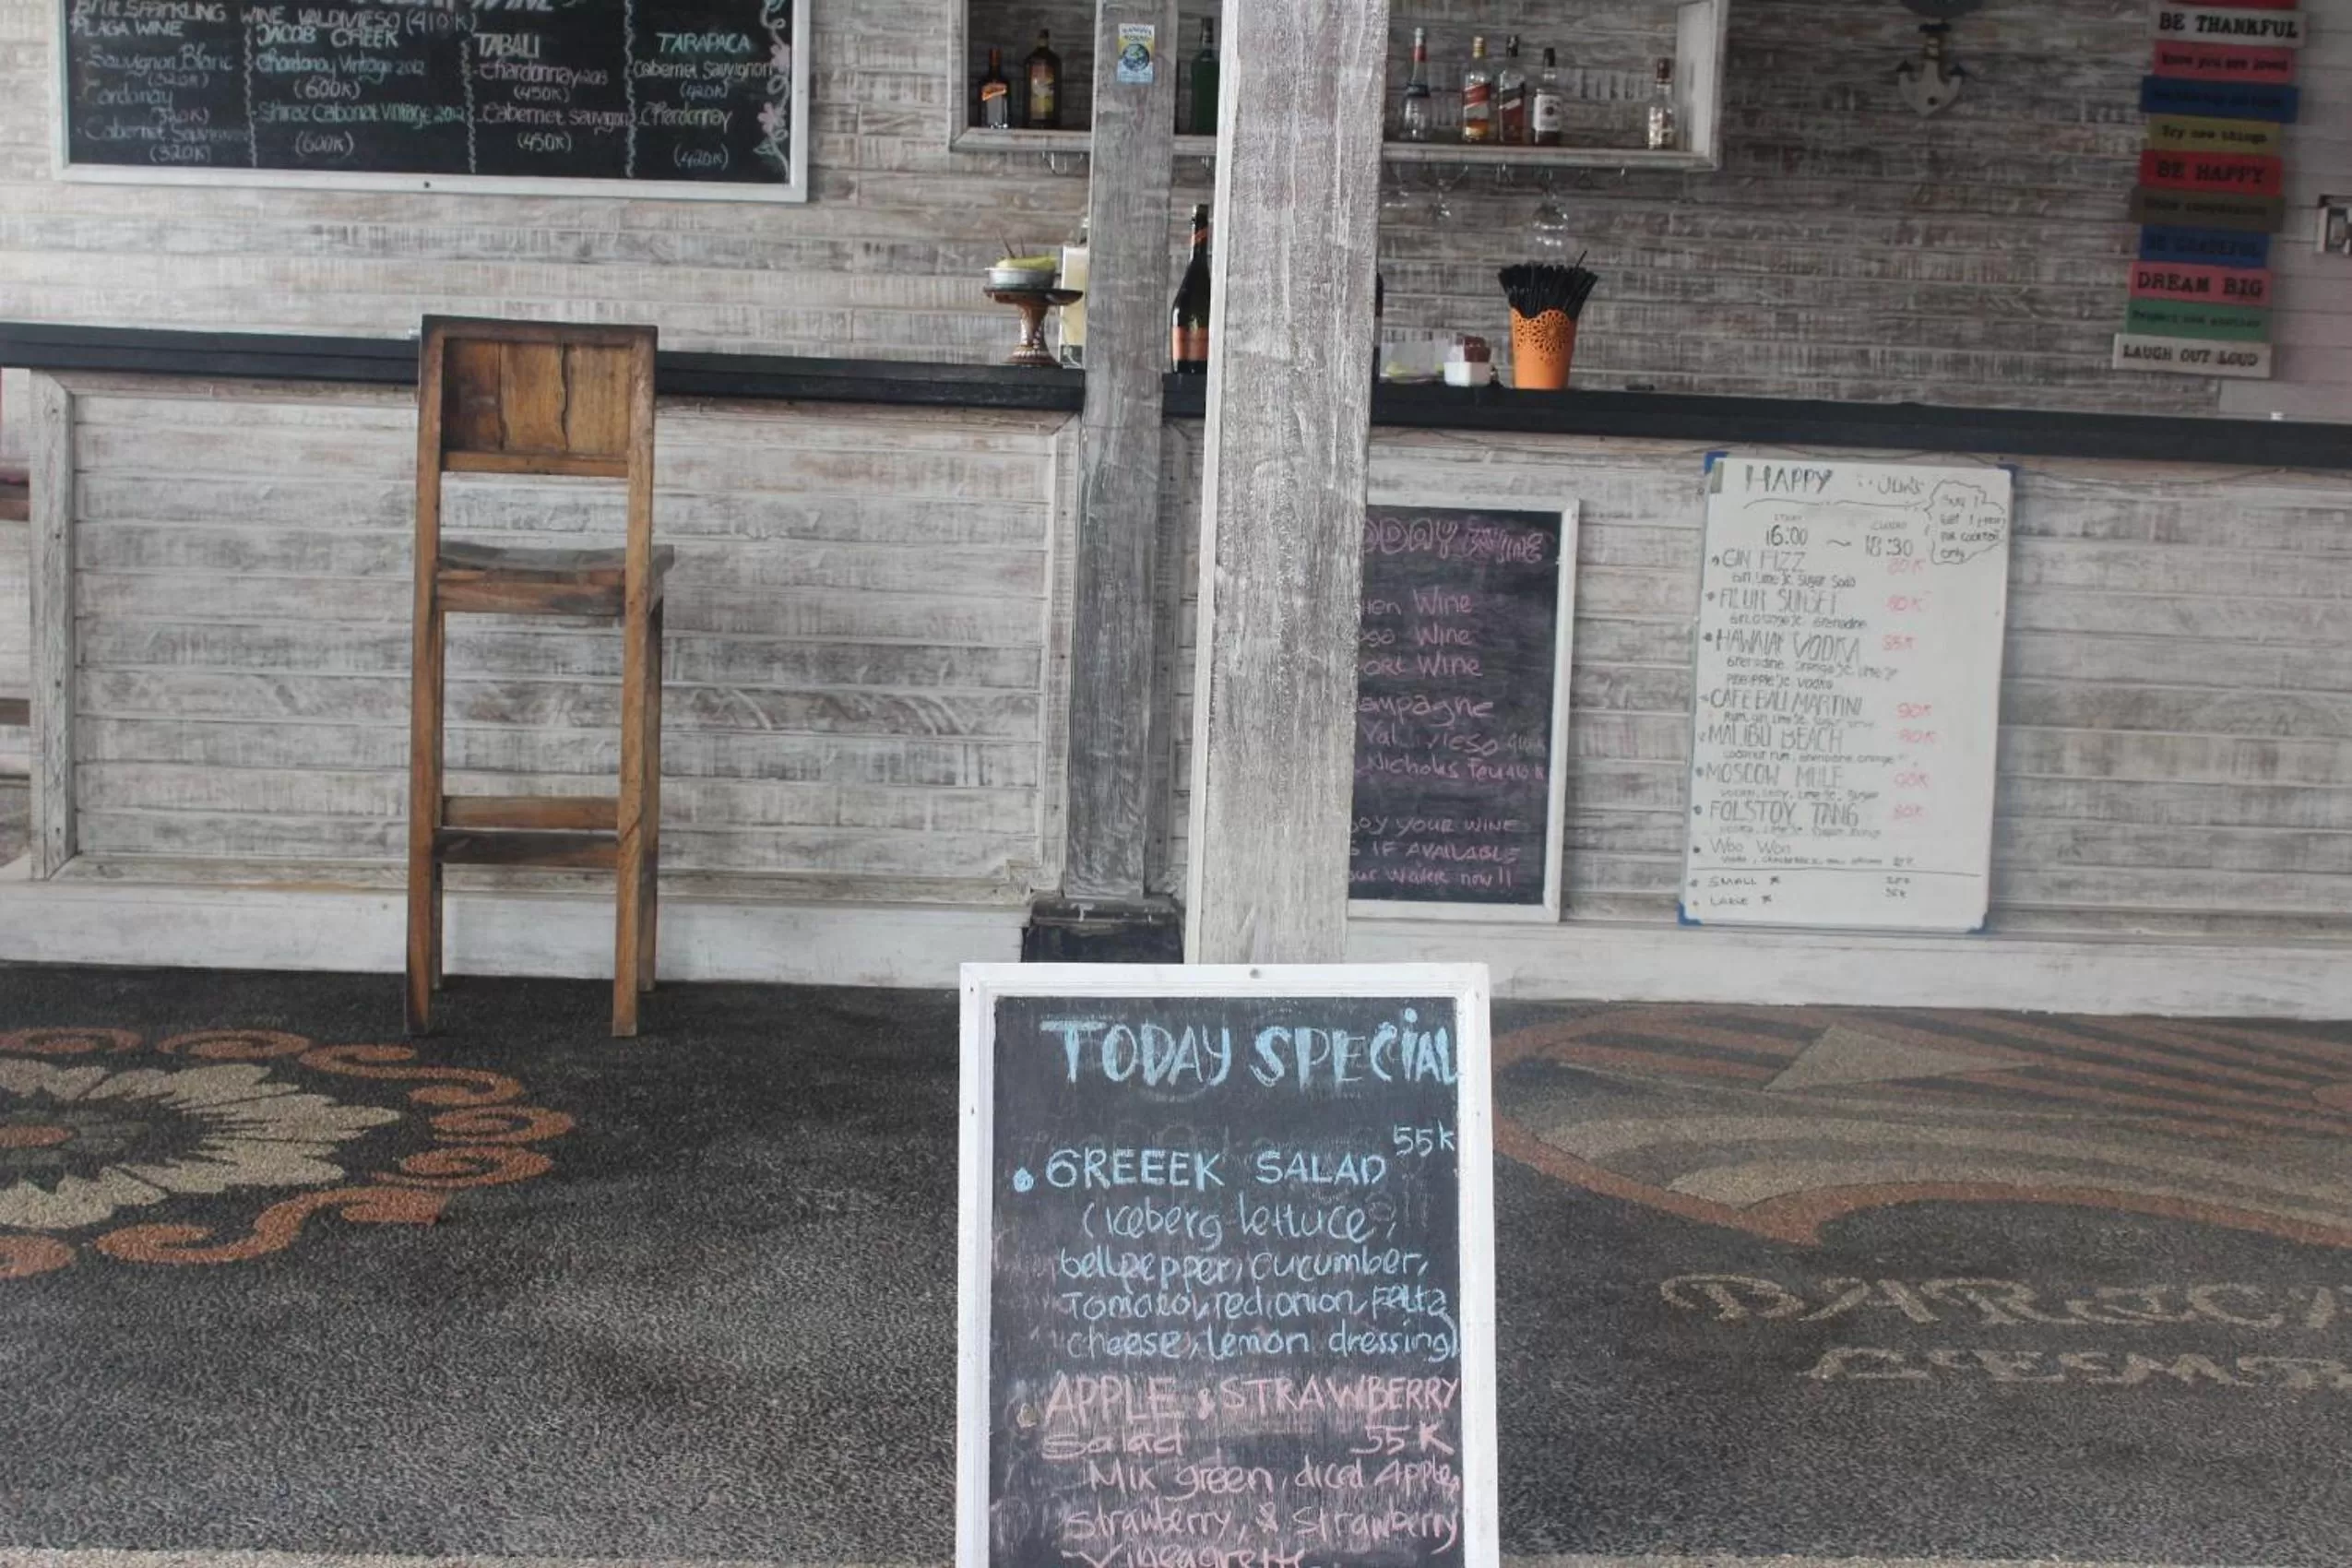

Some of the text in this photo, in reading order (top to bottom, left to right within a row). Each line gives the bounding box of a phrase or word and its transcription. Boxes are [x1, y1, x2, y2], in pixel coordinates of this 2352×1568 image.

[134, 21, 184, 38] WINE
[2159, 11, 2298, 39] BE THANKFUL
[2156, 160, 2265, 184] BE HAPPY
[2137, 271, 2263, 297] DREAM BIG
[2123, 344, 2259, 367] LAUGH OUT LOUD
[1745, 464, 1834, 494] HAPPY
[1764, 524, 1808, 547] 16:00
[1039, 1017, 1231, 1087] TODAY
[1255, 1151, 1385, 1186] SALAD
[1042, 1372, 1183, 1425] APPLE
